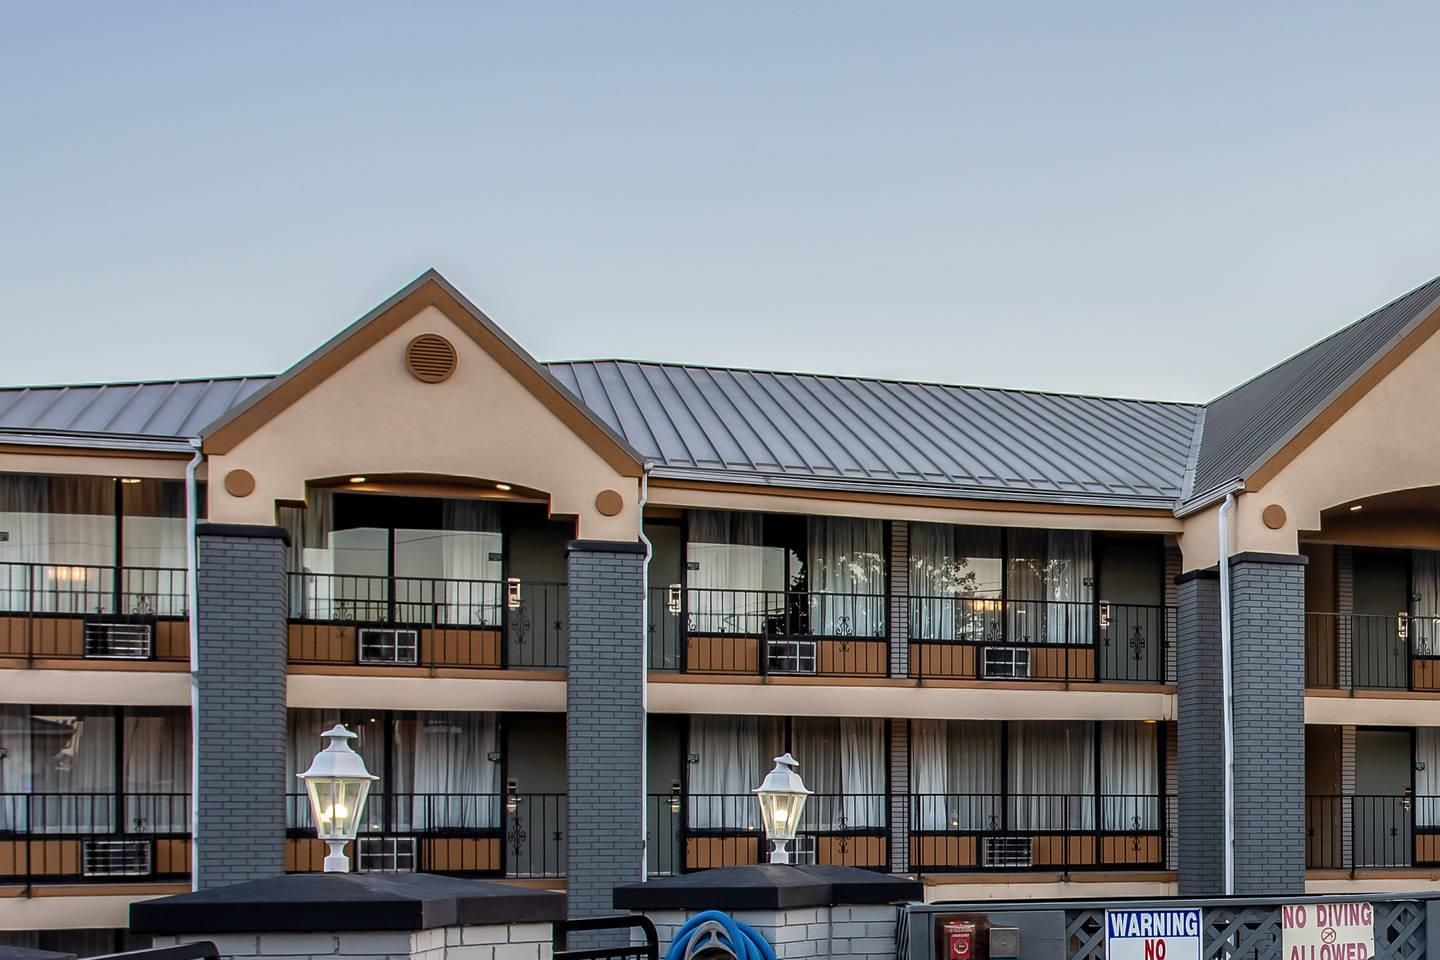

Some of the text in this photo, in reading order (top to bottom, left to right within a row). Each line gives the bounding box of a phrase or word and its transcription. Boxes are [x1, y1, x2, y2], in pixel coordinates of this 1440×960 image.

[1110, 912, 1198, 937] WARNING
[1283, 903, 1371, 929] NO DIVING
